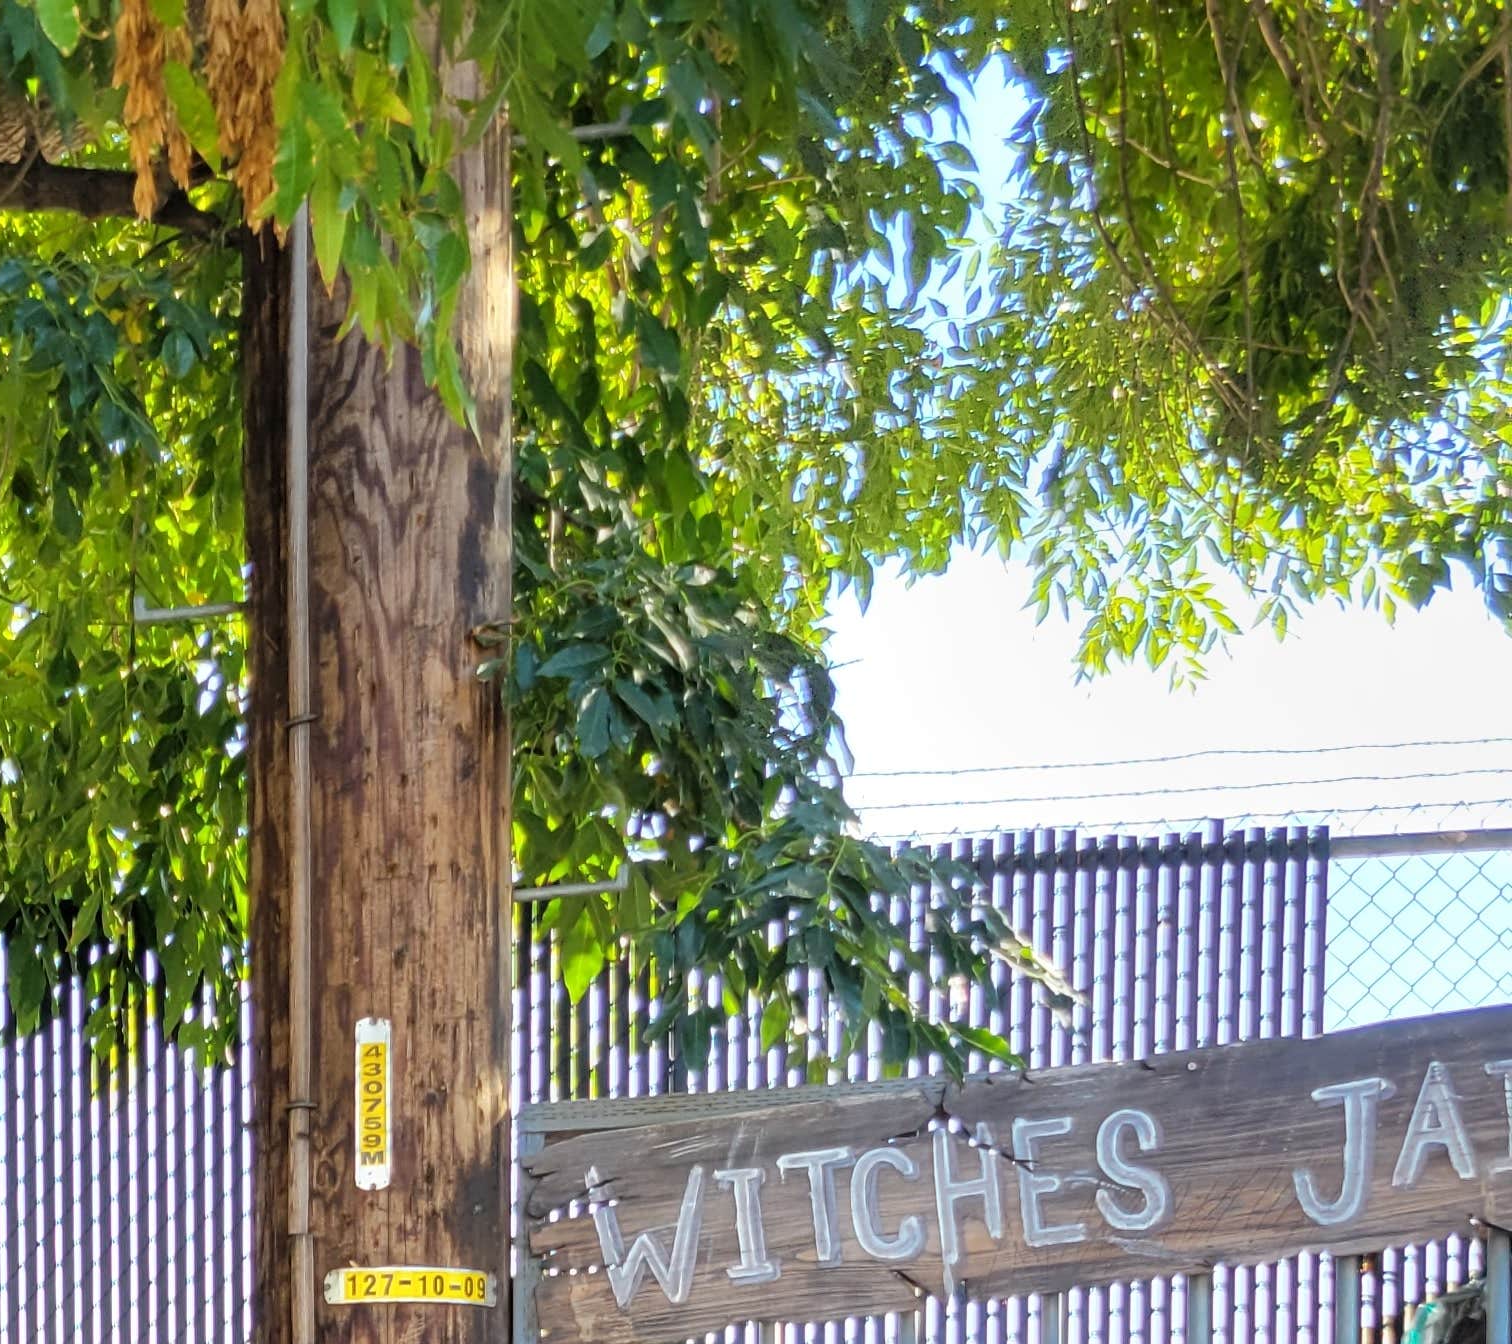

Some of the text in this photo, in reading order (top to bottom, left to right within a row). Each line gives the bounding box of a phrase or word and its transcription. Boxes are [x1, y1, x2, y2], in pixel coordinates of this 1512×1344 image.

[361, 1046, 384, 1165] 430759M
[584, 1108, 1178, 1311] WITCHES
[347, 1273, 486, 1301] 127-10-09
